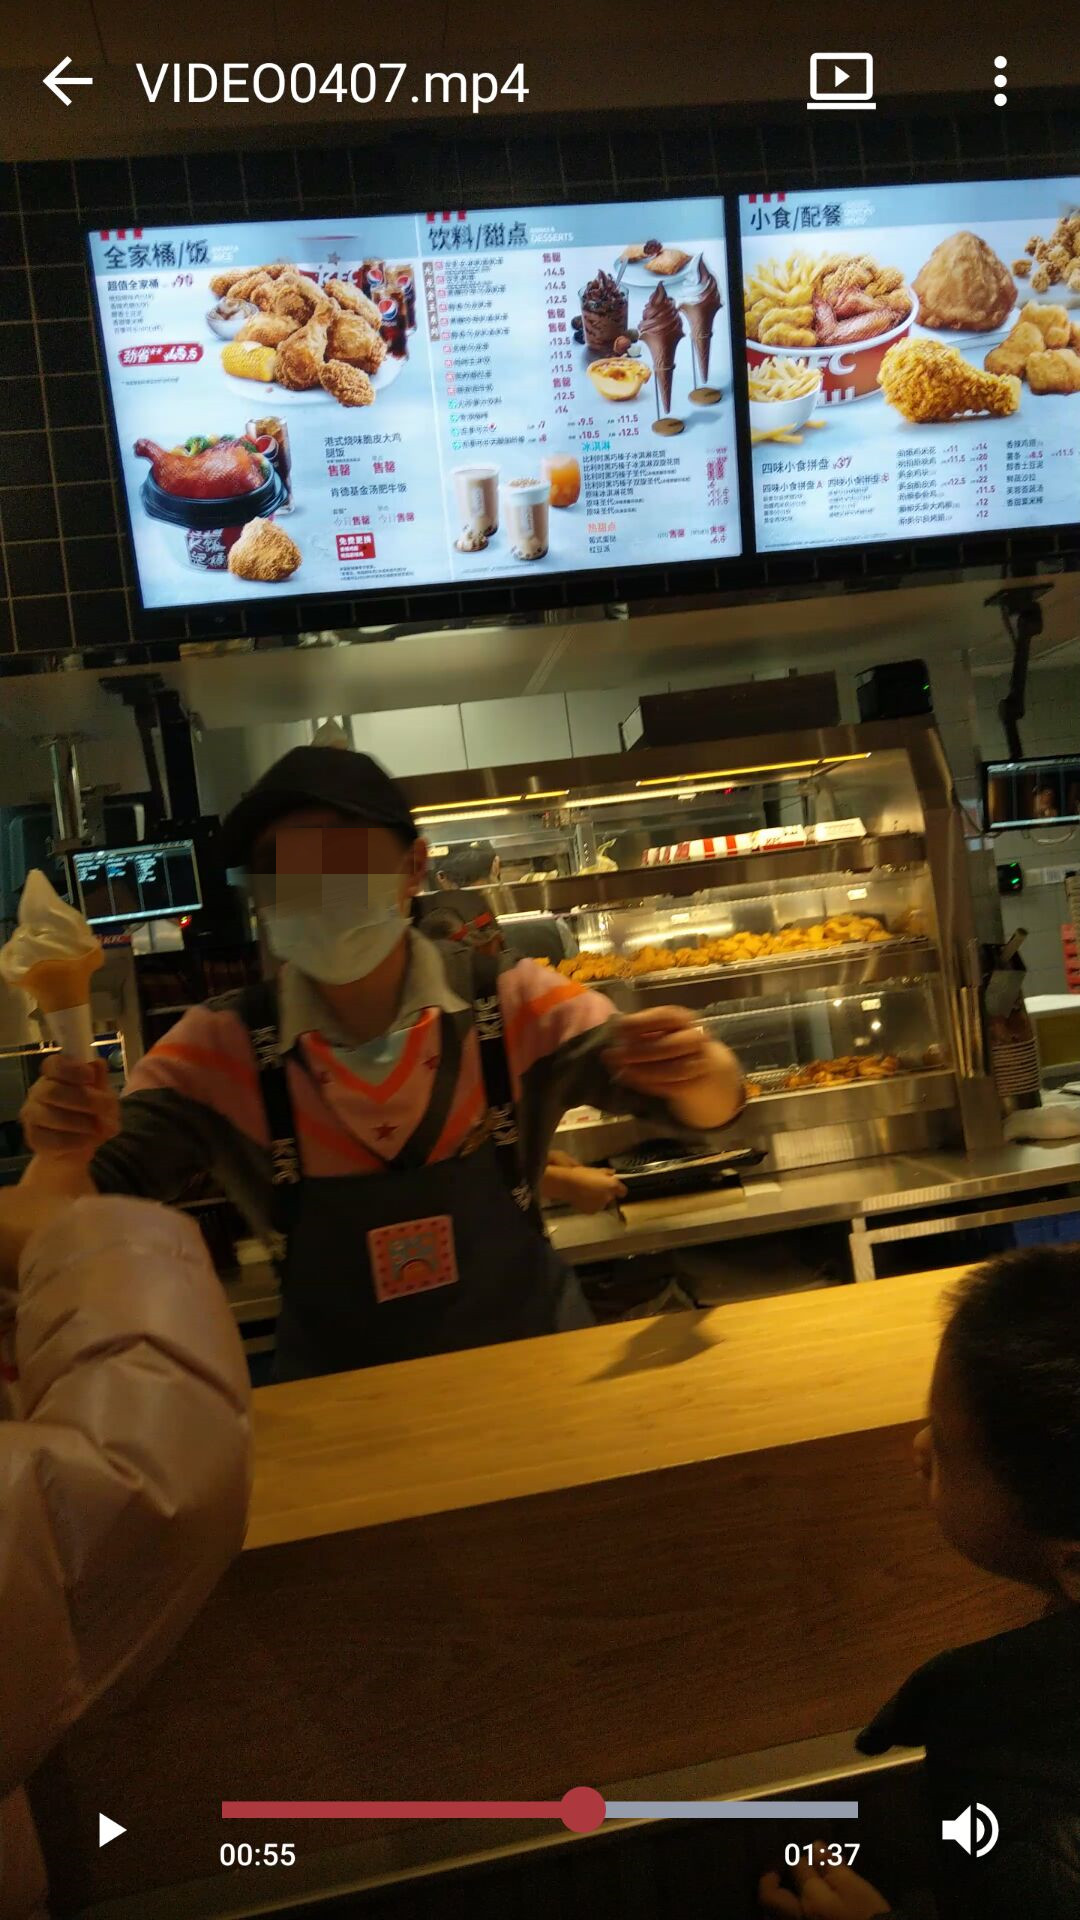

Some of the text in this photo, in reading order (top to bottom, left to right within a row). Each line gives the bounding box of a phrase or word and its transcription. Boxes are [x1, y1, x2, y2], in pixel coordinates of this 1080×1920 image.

[750, 204, 842, 231] 小食/配餐
[428, 221, 528, 251] 饮料/甜点
[104, 239, 210, 270] 全家桶/饭
[761, 458, 830, 475] 四味小食拼盘
